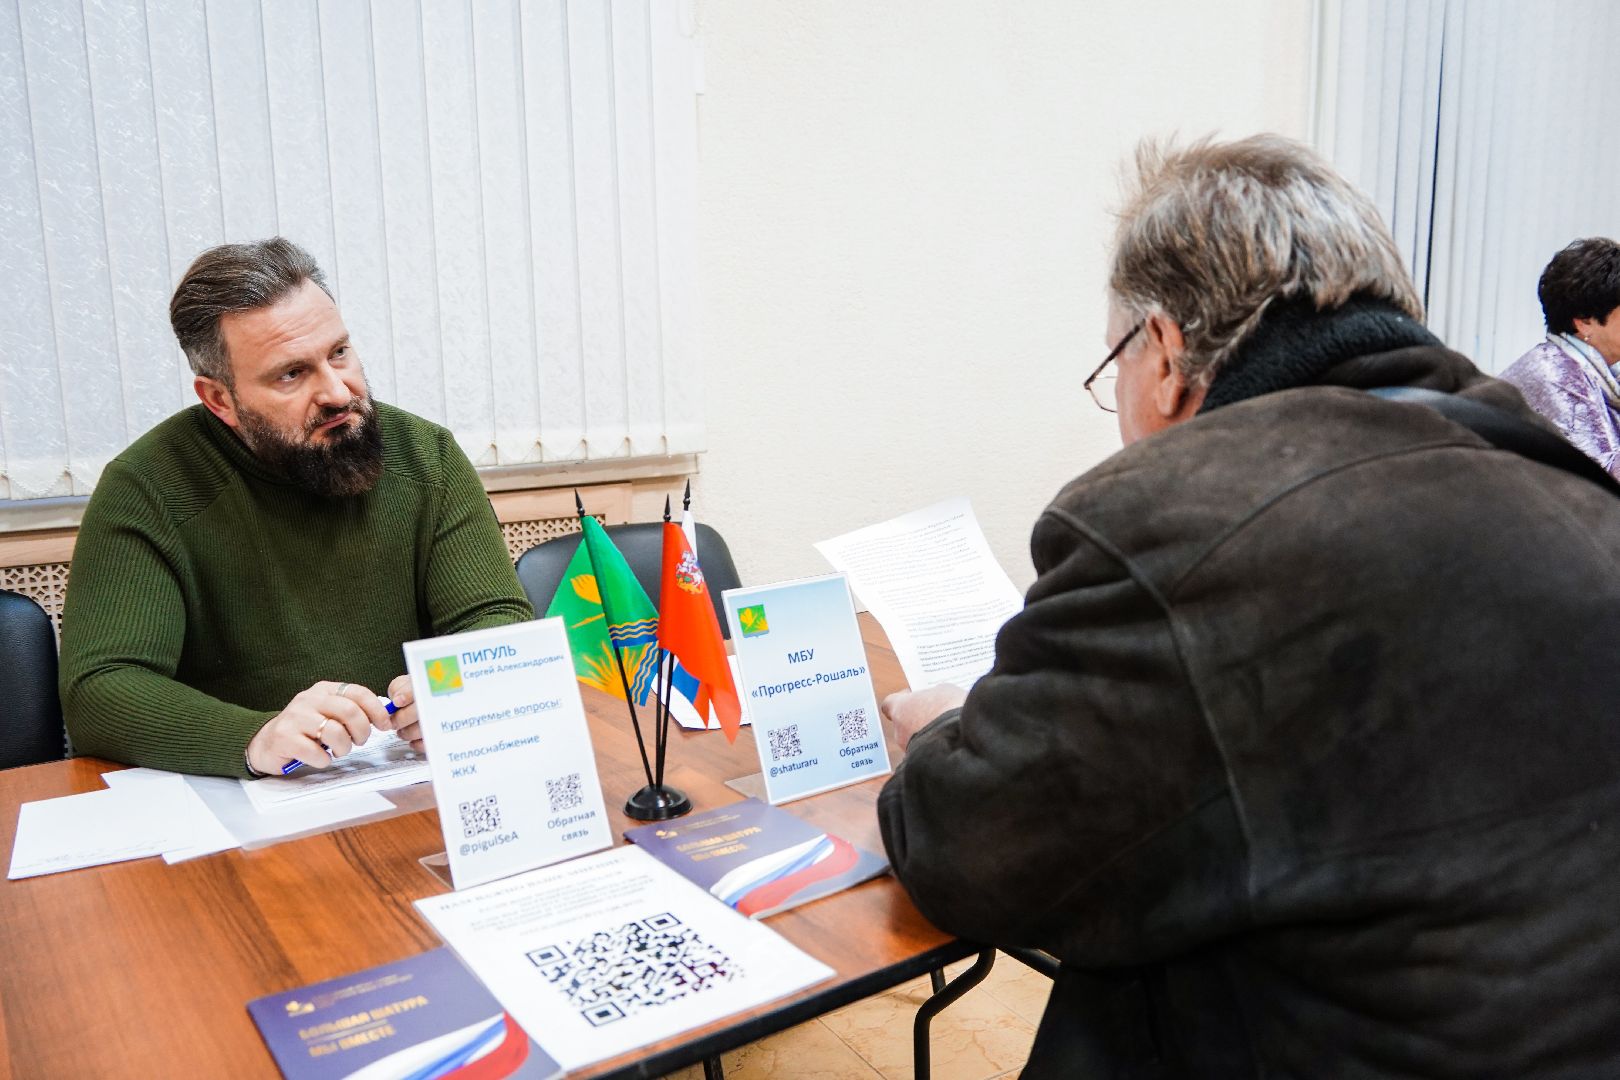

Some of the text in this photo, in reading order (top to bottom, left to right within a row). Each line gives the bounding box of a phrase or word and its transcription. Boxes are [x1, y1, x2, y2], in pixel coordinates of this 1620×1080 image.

[461, 645, 517, 665] ПИГУЛЬ
[787, 648, 815, 664] МБУ
[463, 655, 565, 680] Сергей Александрович
[751, 666, 866, 699] «Прогресс-Рошаль»
[440, 709, 512, 732] Курируемые
[448, 734, 540, 762] Теплоснабжение
[839, 741, 879, 759] Обратная
[451, 764, 478, 778] ЖКХ
[769, 757, 819, 778] @shaturaru
[850, 757, 874, 770] связь
[546, 810, 597, 830] Обратная
[561, 828, 590, 842] связь
